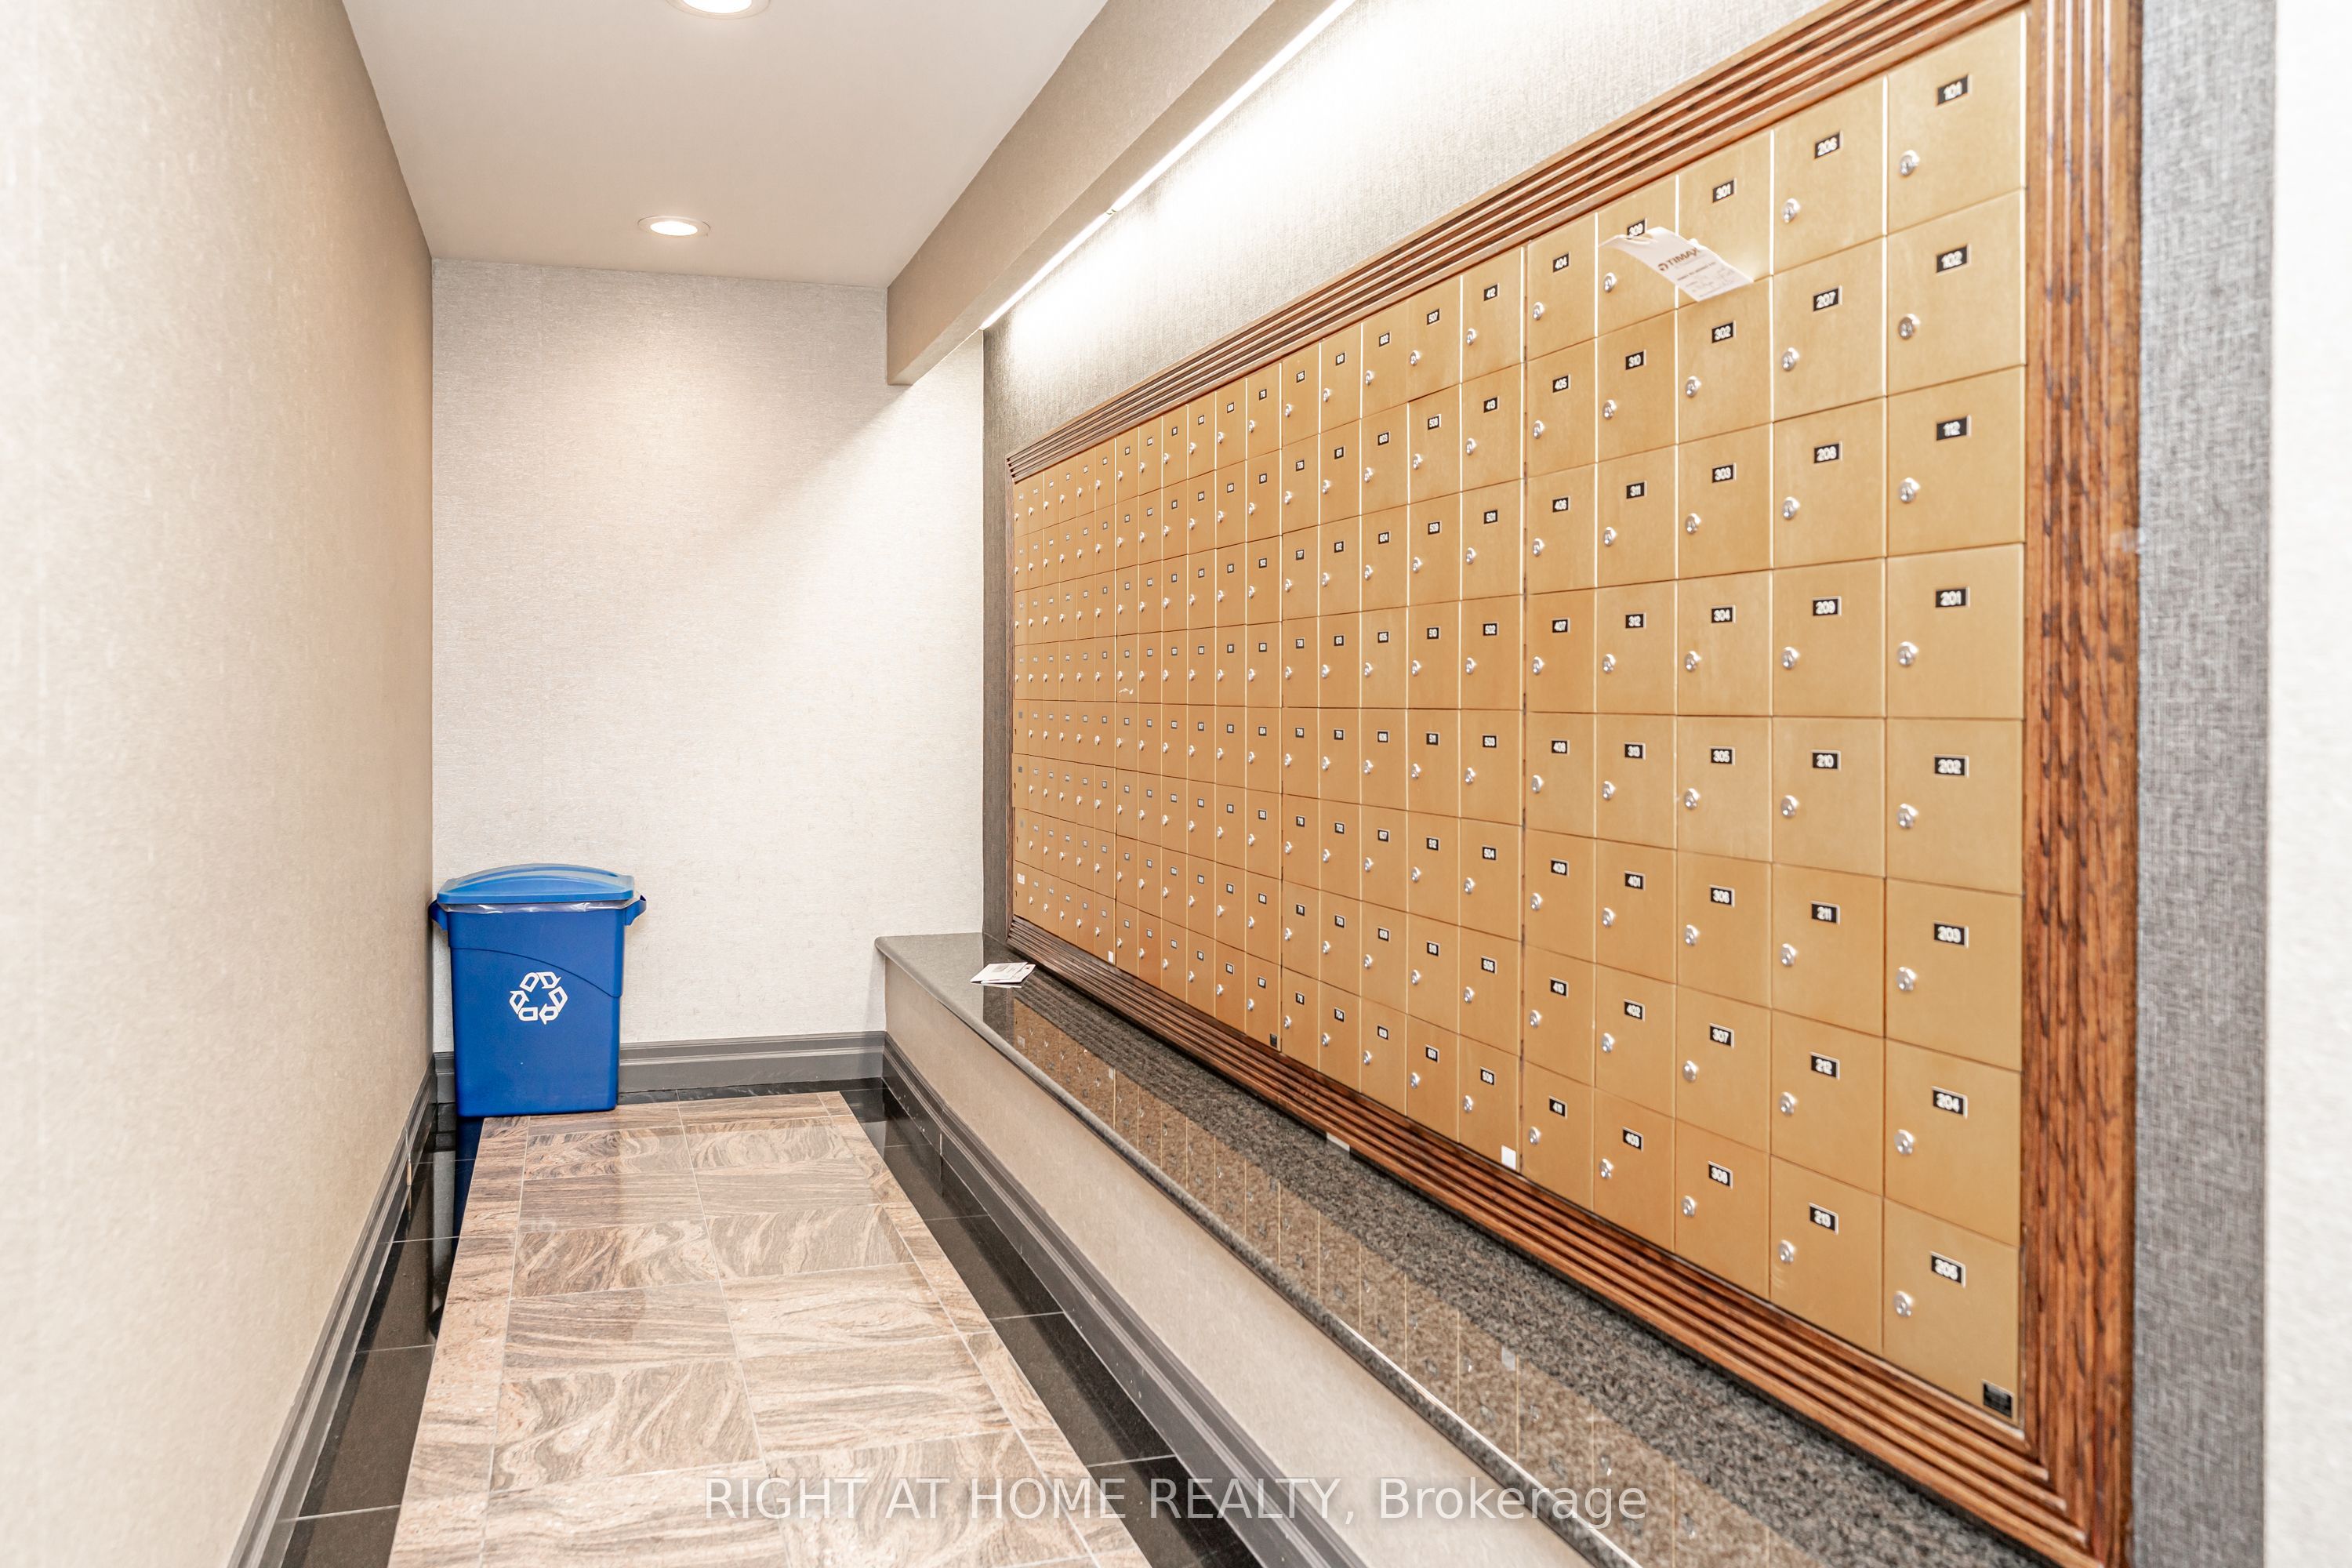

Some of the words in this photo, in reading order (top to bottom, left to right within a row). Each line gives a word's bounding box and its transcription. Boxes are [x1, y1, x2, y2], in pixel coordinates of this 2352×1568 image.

[1943, 81, 1963, 101] 101
[1817, 136, 1838, 157] 206
[1715, 183, 1731, 200] 301
[1554, 256, 1568, 270] 404
[1941, 250, 1963, 270] 102
[1486, 287, 1496, 299] 412
[1816, 291, 1836, 309] 207
[1714, 325, 1731, 340] 302
[1628, 354, 1642, 368] 310
[1554, 378, 1568, 390] 405
[1943, 420, 1961, 437] 112
[1817, 445, 1837, 462] 208
[1714, 466, 1732, 481] 303
[1630, 485, 1642, 497] 311
[1940, 590, 1962, 607] 201
[1714, 608, 1731, 622] 304
[1816, 600, 1836, 615] 209
[1628, 615, 1642, 627] 312
[1713, 750, 1730, 763] 305
[1816, 754, 1835, 768] 210
[1938, 759, 1962, 775] 202
[1628, 875, 1641, 887] 401
[1712, 889, 1730, 904] 306
[1817, 906, 1832, 921] 211
[1937, 925, 1962, 943] 203
[1712, 1029, 1730, 1044] 307
[1815, 1058, 1833, 1075] 212
[1936, 1093, 1960, 1112] 204
[1935, 1258, 1958, 1280] 205
